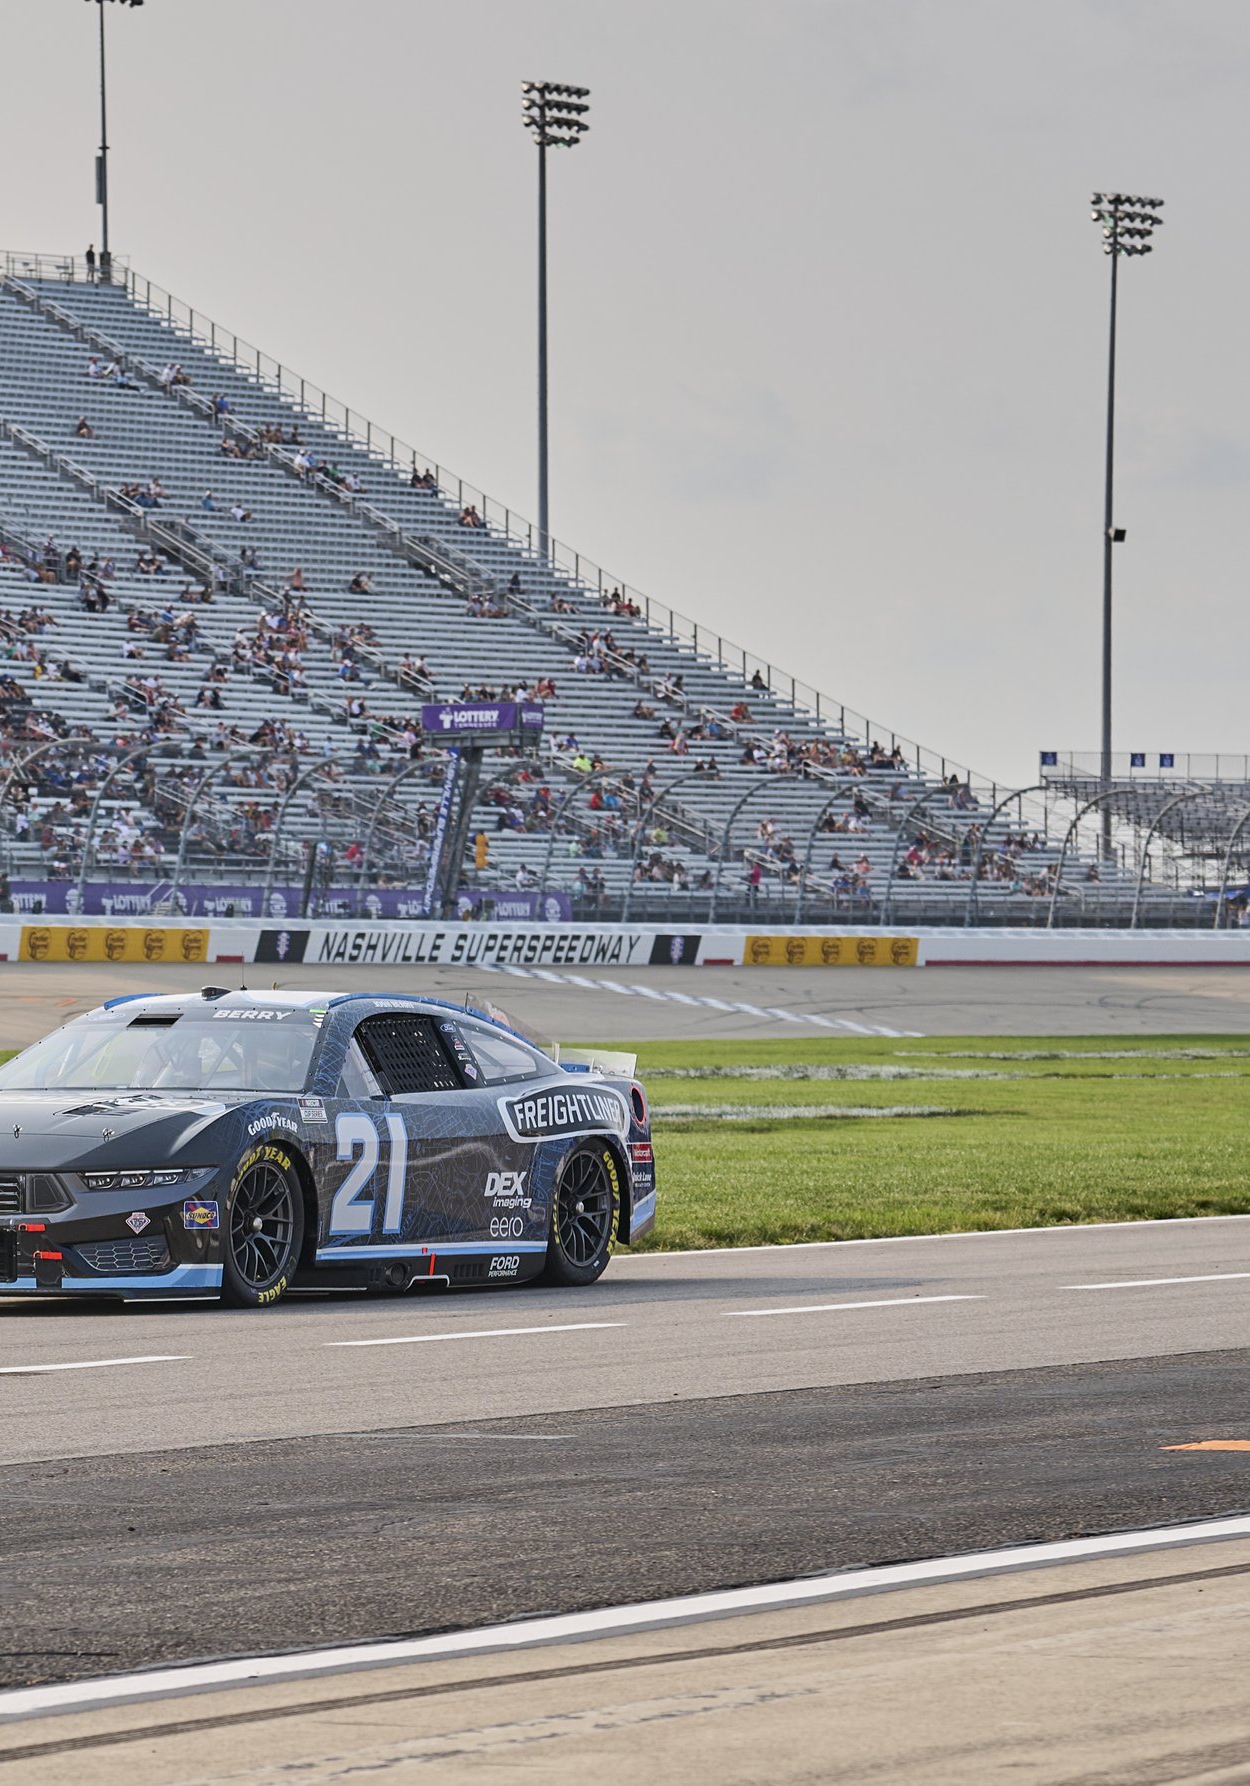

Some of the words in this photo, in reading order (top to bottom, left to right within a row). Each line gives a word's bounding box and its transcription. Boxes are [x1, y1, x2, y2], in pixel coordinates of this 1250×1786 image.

[454, 710, 499, 723] LOTTERY
[10, 893, 47, 909] OTTERY
[318, 931, 445, 962] NASHVILLE
[451, 933, 640, 964] SUPERSPEEDWAY
[213, 1009, 292, 1020] BERRY
[513, 1094, 622, 1130] FREIGHTLINER
[248, 1112, 298, 1136] GOODYEAR
[329, 1112, 409, 1235] 21
[484, 1171, 527, 1197] DEX
[493, 1195, 533, 1209] imaging
[187, 1211, 215, 1220] SUNOCO
[490, 1217, 524, 1237] eero
[490, 1255, 520, 1270] FORD
[488, 1269, 518, 1278] PERFORMANCE
[258, 1275, 287, 1303] EAGLE
